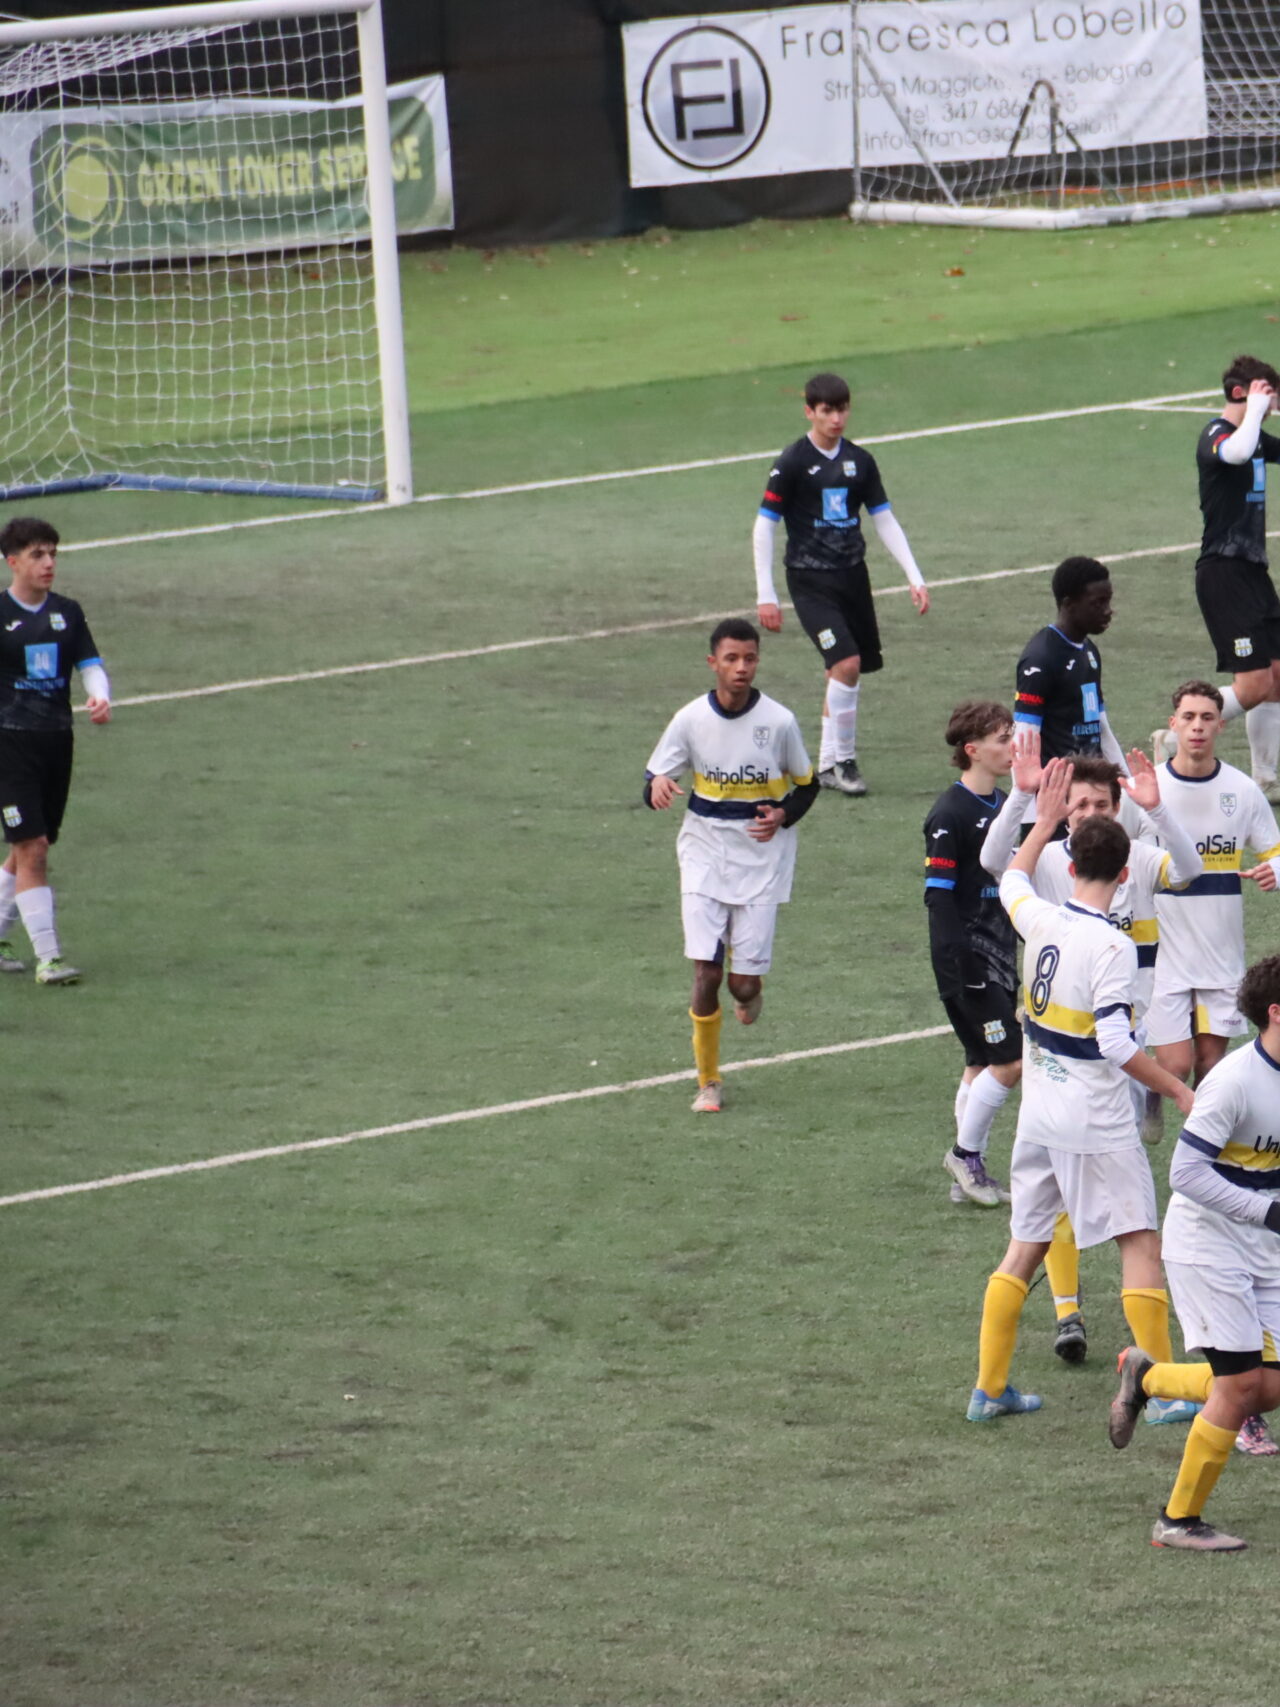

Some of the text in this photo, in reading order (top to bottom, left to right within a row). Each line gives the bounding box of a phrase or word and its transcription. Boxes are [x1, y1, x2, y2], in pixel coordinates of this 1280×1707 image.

[780, 1, 1187, 60] Francesca Lobello
[824, 79, 897, 101] Strada
[1064, 61, 1153, 84] Bologna
[137, 135, 423, 208] GREEN POWER SERCE
[1030, 944, 1061, 1017] 8
